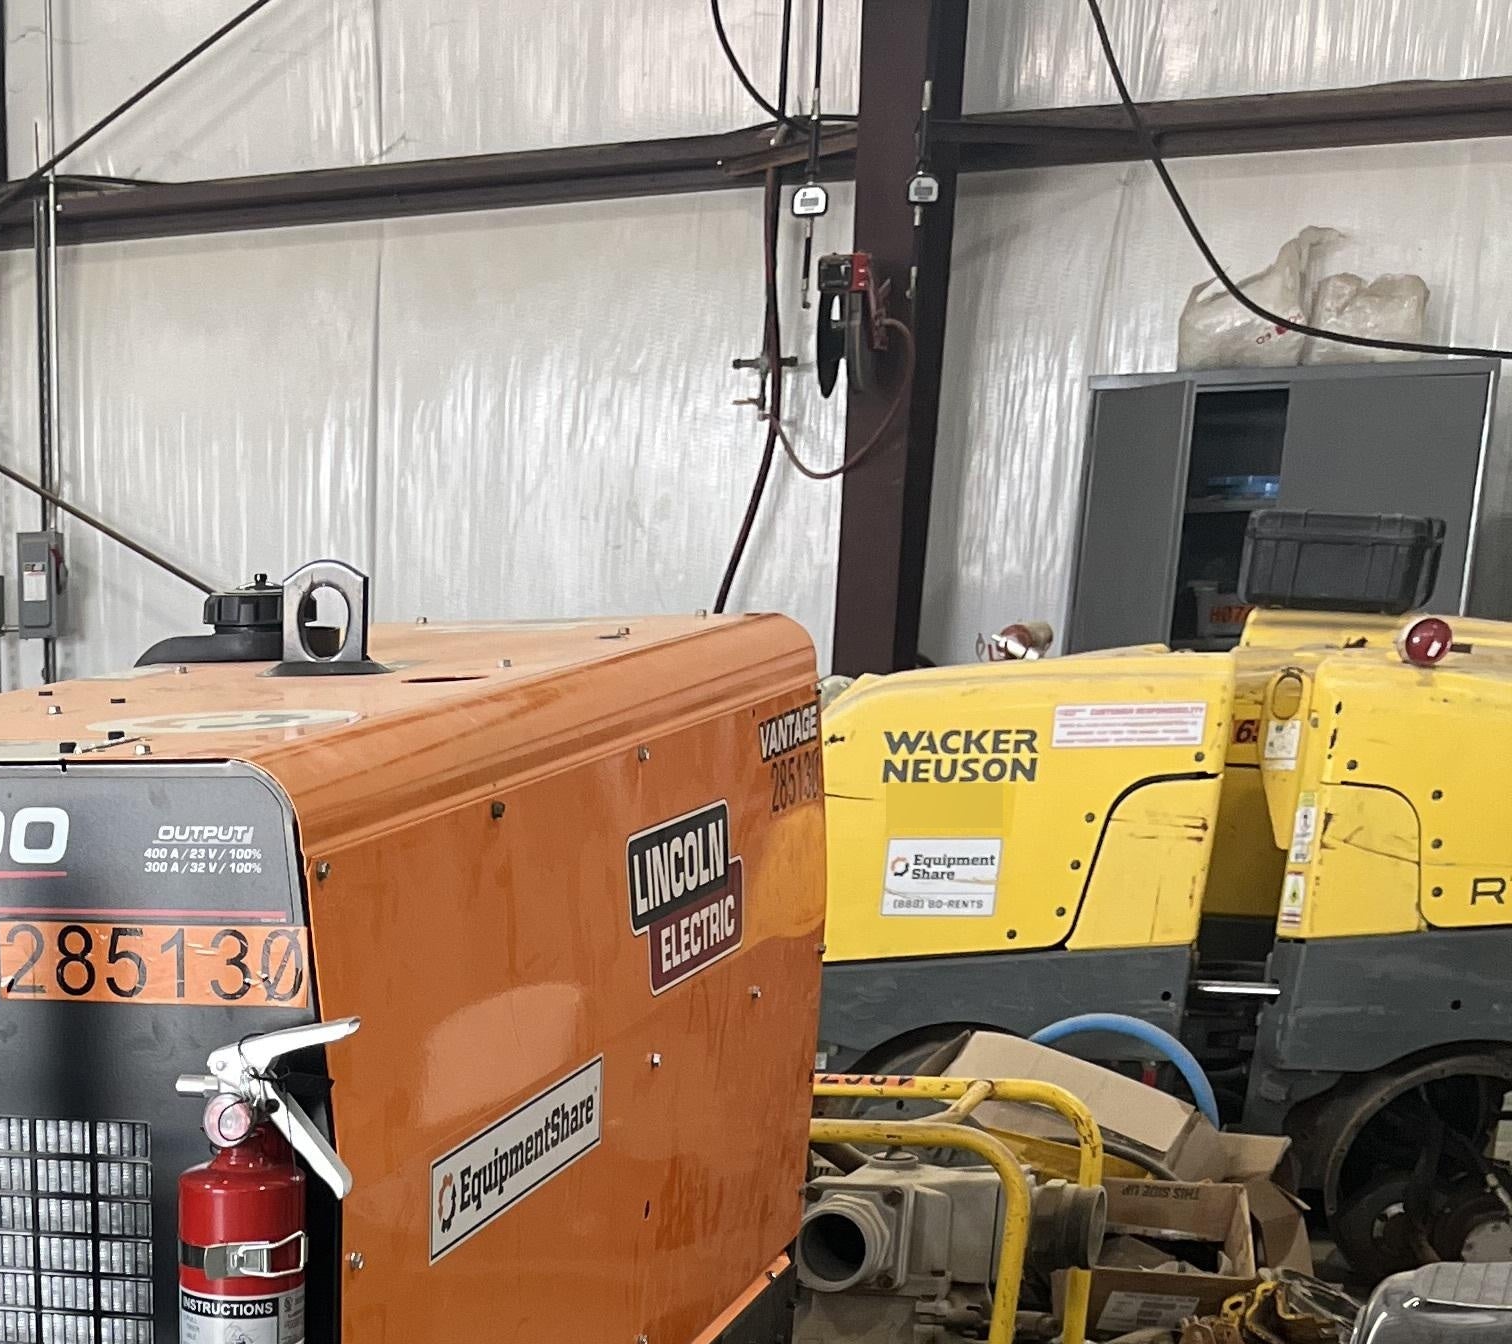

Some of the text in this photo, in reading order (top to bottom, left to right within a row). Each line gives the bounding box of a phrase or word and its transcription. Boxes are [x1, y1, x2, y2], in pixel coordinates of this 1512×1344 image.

[759, 704, 817, 760] VANTAGE
[883, 729, 1039, 755] WACKER
[881, 758, 1038, 783] NEUSON
[158, 825, 247, 841] OUTPUT
[144, 848, 168, 859] 400
[170, 848, 179, 859] A
[190, 849, 205, 859] 23
[208, 849, 216, 859] V
[229, 849, 262, 859] 100%
[913, 854, 996, 868] Equipment
[144, 862, 168, 873] 300
[170, 862, 179, 873] A
[190, 862, 205, 873] 32
[208, 863, 217, 873] V
[229, 862, 262, 874] 100%
[633, 818, 726, 917] LINCOLN
[911, 868, 955, 880] Share
[927, 899, 984, 909] 80-RENTS
[1470, 877, 1512, 906] R
[661, 895, 736, 974] ELECTRIC
[5, 924, 304, 1000] 285130
[458, 1092, 594, 1211] EquipmentShare
[183, 1296, 273, 1317] INSTRUCTIONS
